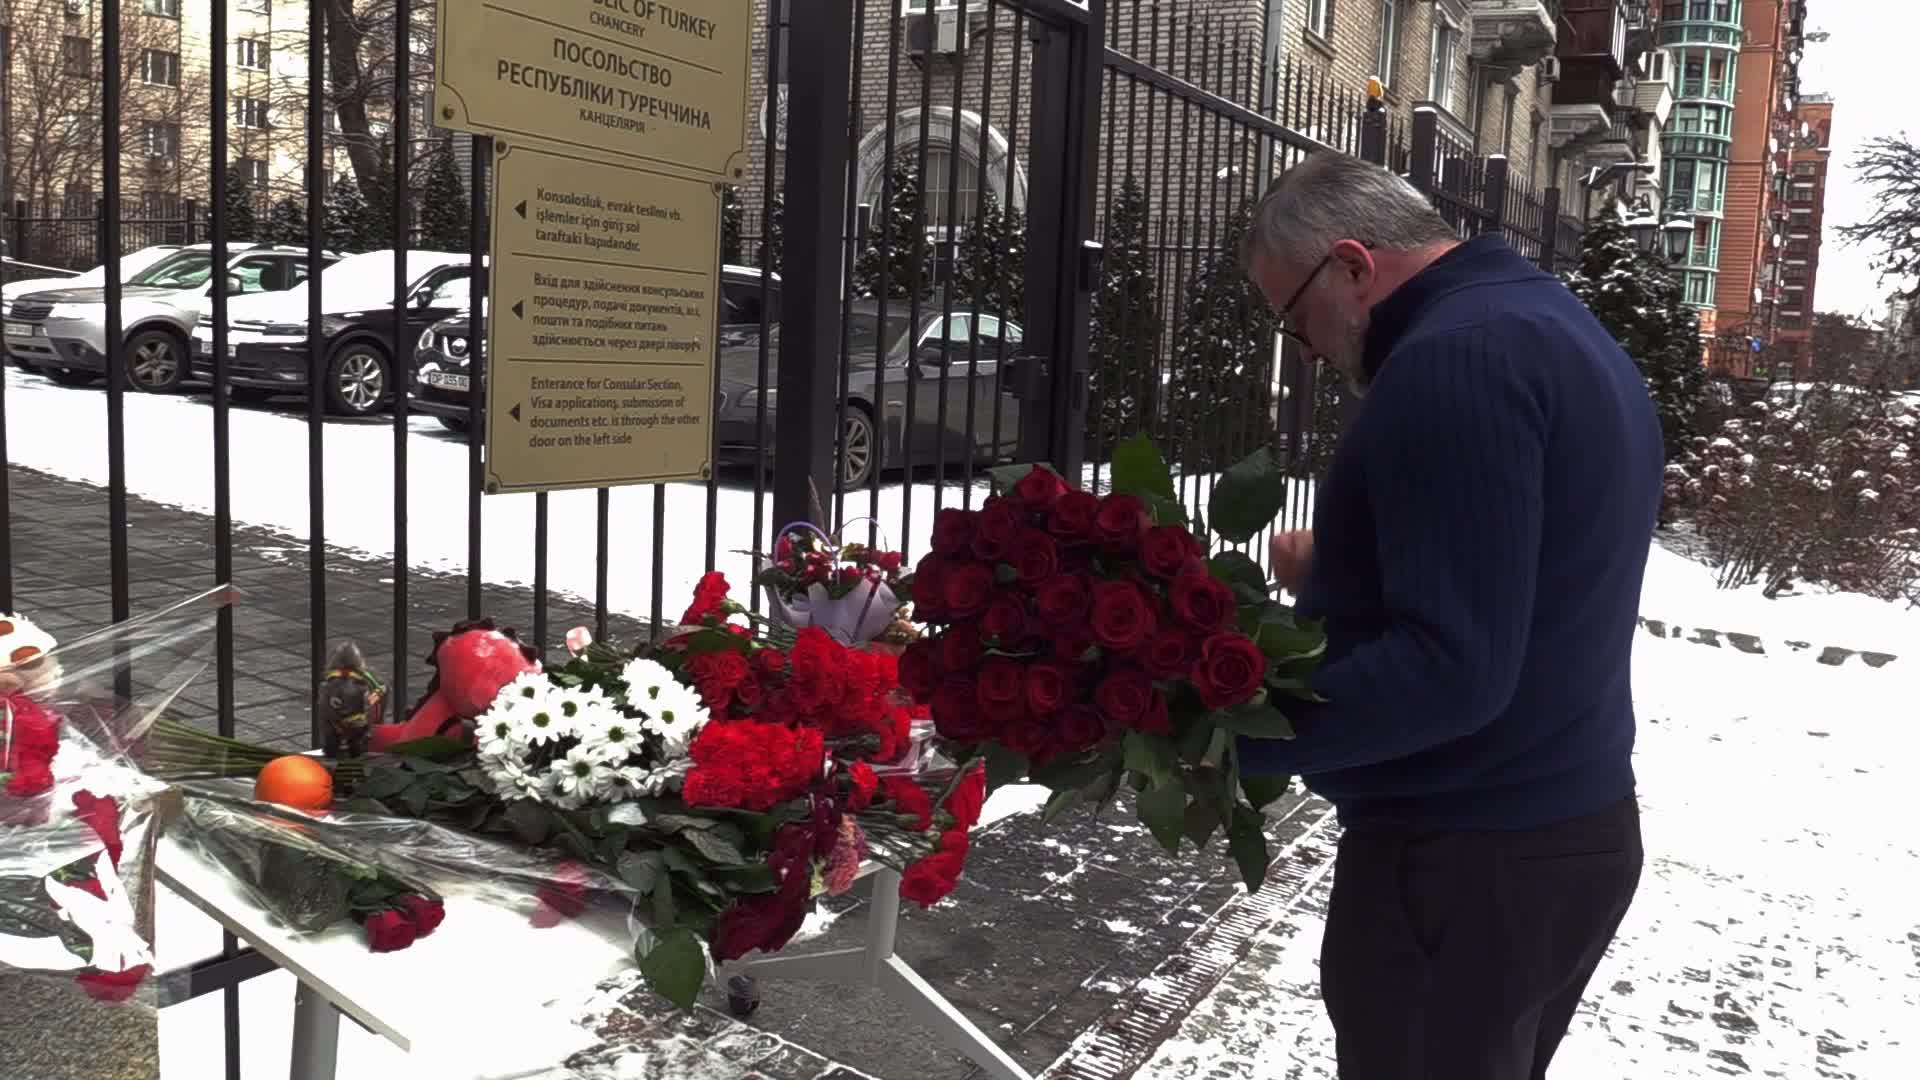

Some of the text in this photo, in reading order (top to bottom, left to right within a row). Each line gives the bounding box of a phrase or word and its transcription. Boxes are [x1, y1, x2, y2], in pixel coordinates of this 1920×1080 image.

[590, 11, 646, 37] CHANCERY
[633, 0, 656, 20] OF
[658, 5, 716, 40] TURKEY
[553, 38, 671, 87] ПОСОЛЬСТВО
[497, 59, 710, 130] РЕСПУБЛІКИ ТУРЕЧЧИНА
[579, 108, 645, 134] КАНЦЕЛЯРІЯ
[537, 187, 604, 210] Konsolosluk,
[607, 200, 635, 214] evrak
[636, 204, 668, 219] teslimi
[536, 208, 579, 225] işlemler
[581, 213, 600, 230] için
[625, 220, 640, 233] sol
[535, 228, 582, 245] taraftaki
[534, 272, 558, 288] Вхід
[560, 278, 580, 289] для
[533, 295, 591, 311] процедур,
[533, 314, 569, 326] пошти
[571, 317, 584, 328] та
[531, 376, 682, 392] Enterance for Consular Section,
[530, 395, 552, 409] Visa
[623, 396, 673, 408] submission
[675, 395, 685, 408] of
[530, 415, 589, 428] documents
[611, 415, 619, 426] is
[621, 414, 659, 428] through
[661, 413, 675, 425] the
[677, 414, 700, 425] other
[529, 432, 632, 447] door on the left side
